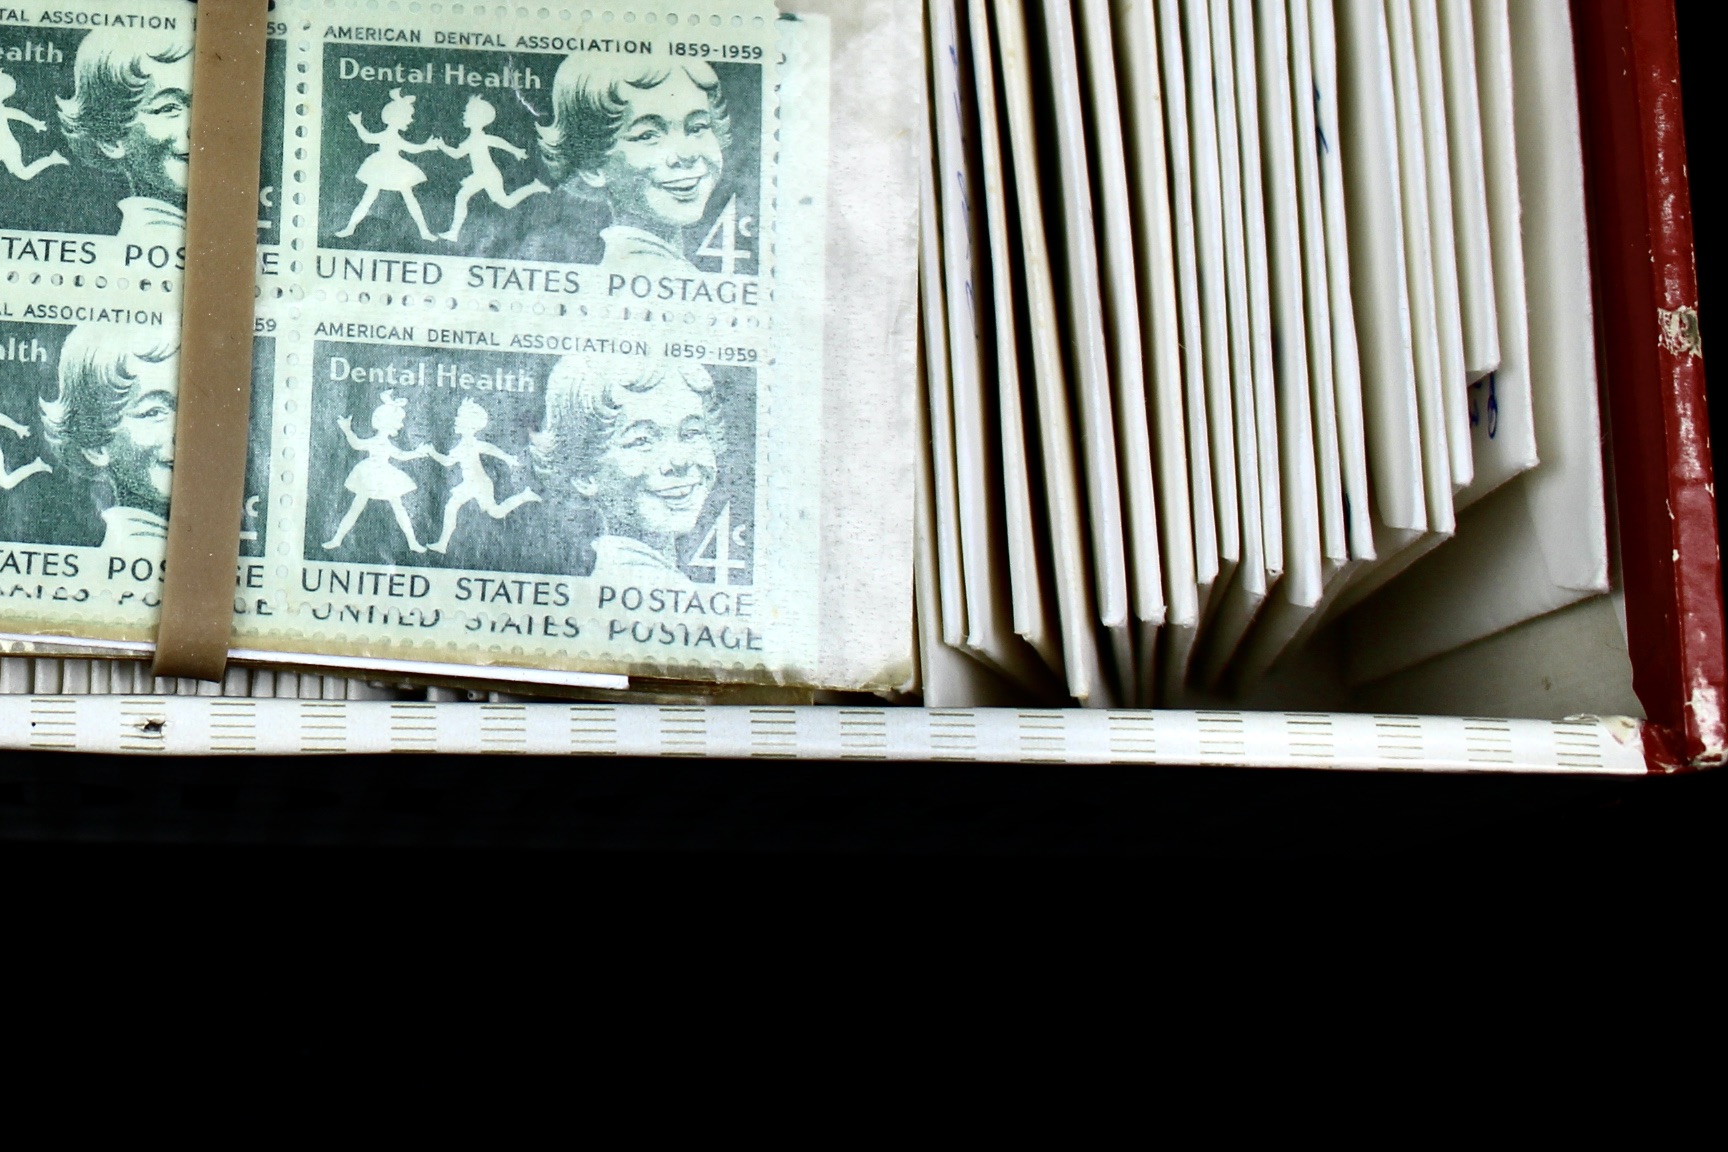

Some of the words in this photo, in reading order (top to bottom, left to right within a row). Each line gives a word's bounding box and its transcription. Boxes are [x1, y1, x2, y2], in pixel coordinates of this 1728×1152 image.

[40, 9, 177, 31] ASSOCIATION
[323, 24, 421, 44] AMERICAN
[434, 32, 508, 49] DENTAL
[516, 35, 653, 56] ASSOCIATION
[667, 41, 763, 60] 1859-1959
[338, 57, 433, 85] Dental
[443, 62, 542, 91] Health
[316, 256, 443, 286] UNITED
[467, 265, 580, 295] STATES
[608, 274, 759, 307] POSTAGE
[22, 303, 163, 326] ASSOCIATION
[314, 321, 415, 342] AMERICAN
[427, 328, 501, 347] DENTAL
[509, 333, 648, 356] ASSOCIATION
[663, 342, 758, 363] 1859-1959
[329, 357, 426, 387] Dental
[437, 365, 536, 393] Health
[301, 567, 430, 599] UNITED
[454, 576, 571, 608] STATES
[597, 585, 756, 617] POSTAGE
